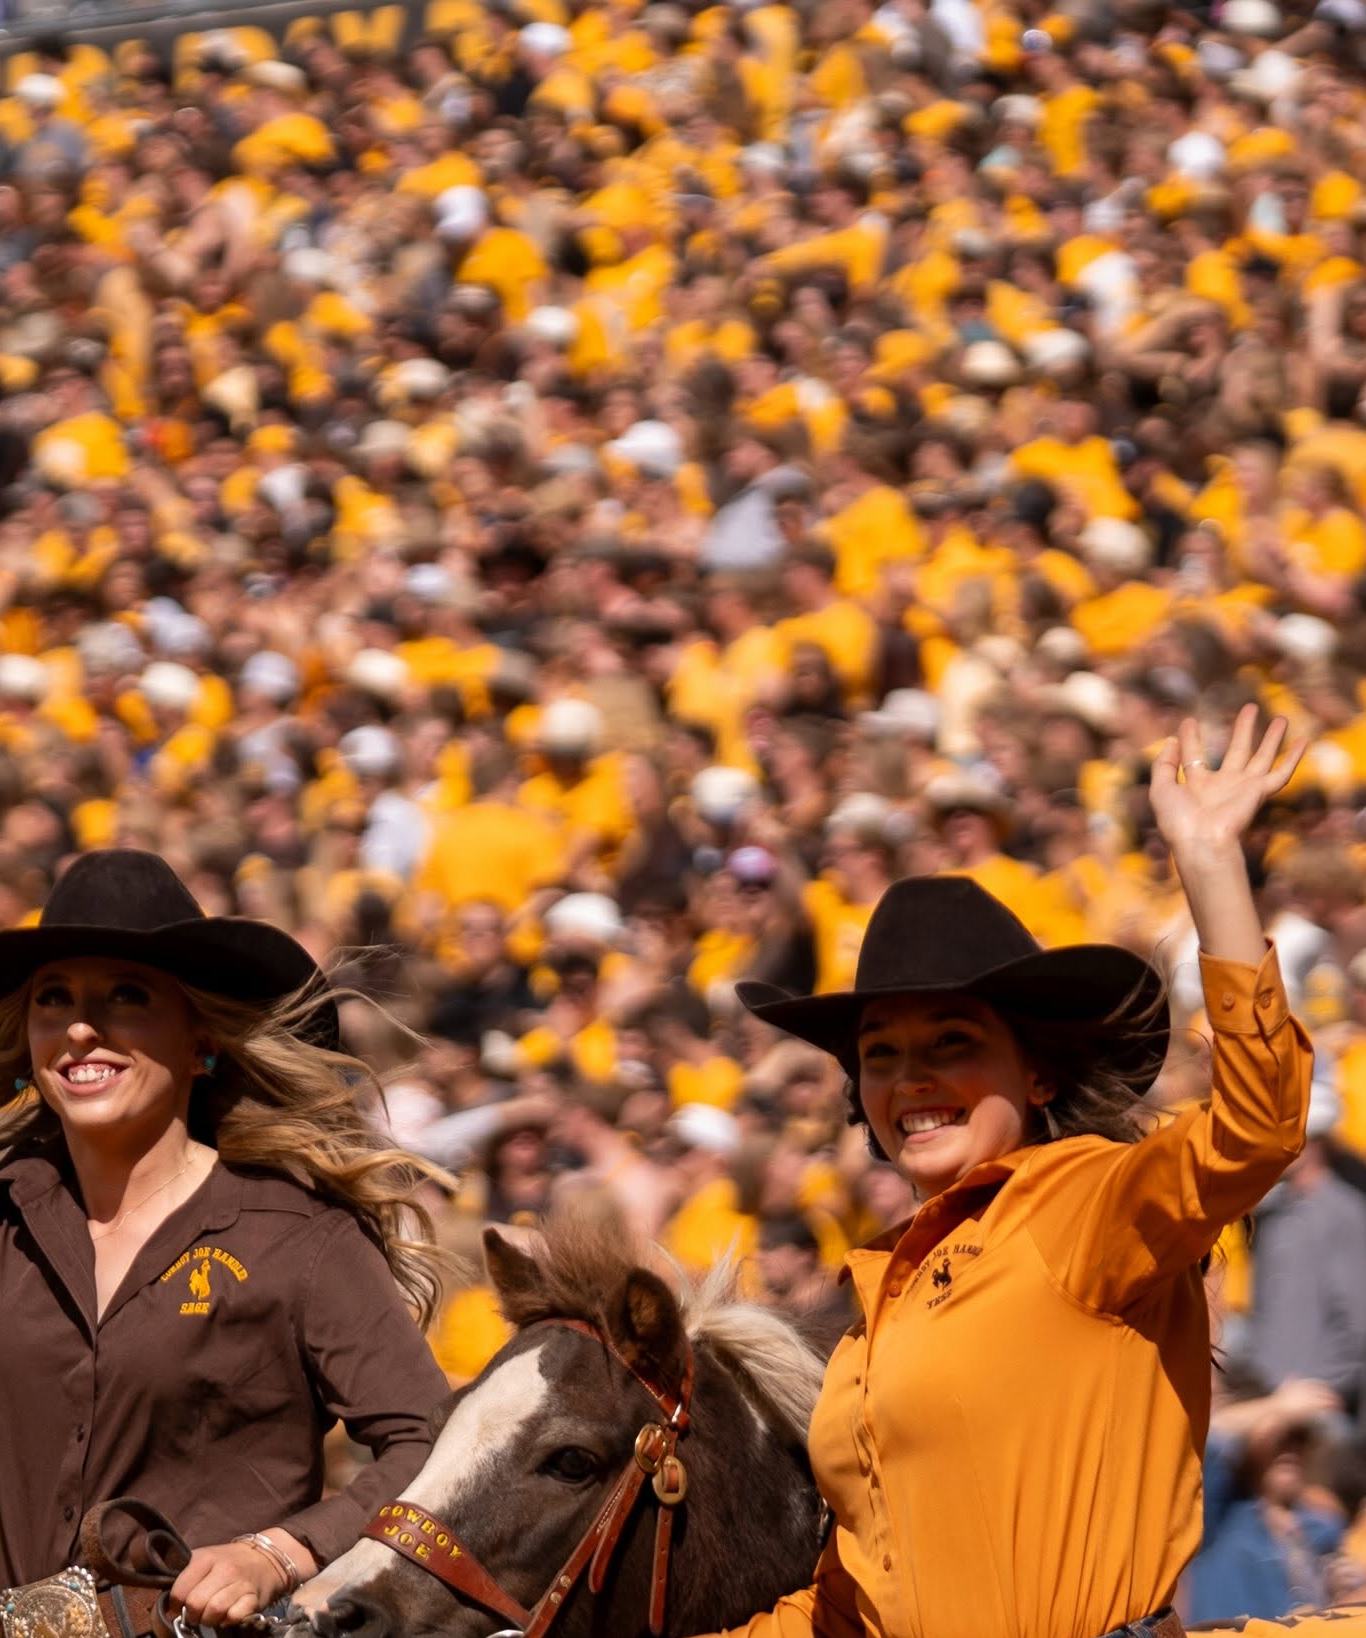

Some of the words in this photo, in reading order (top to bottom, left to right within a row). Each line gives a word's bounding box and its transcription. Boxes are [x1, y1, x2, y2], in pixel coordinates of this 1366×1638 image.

[179, 1301, 211, 1315] SAGE
[379, 1504, 463, 1558] COWBOY
[384, 1525, 431, 1559] JOE
